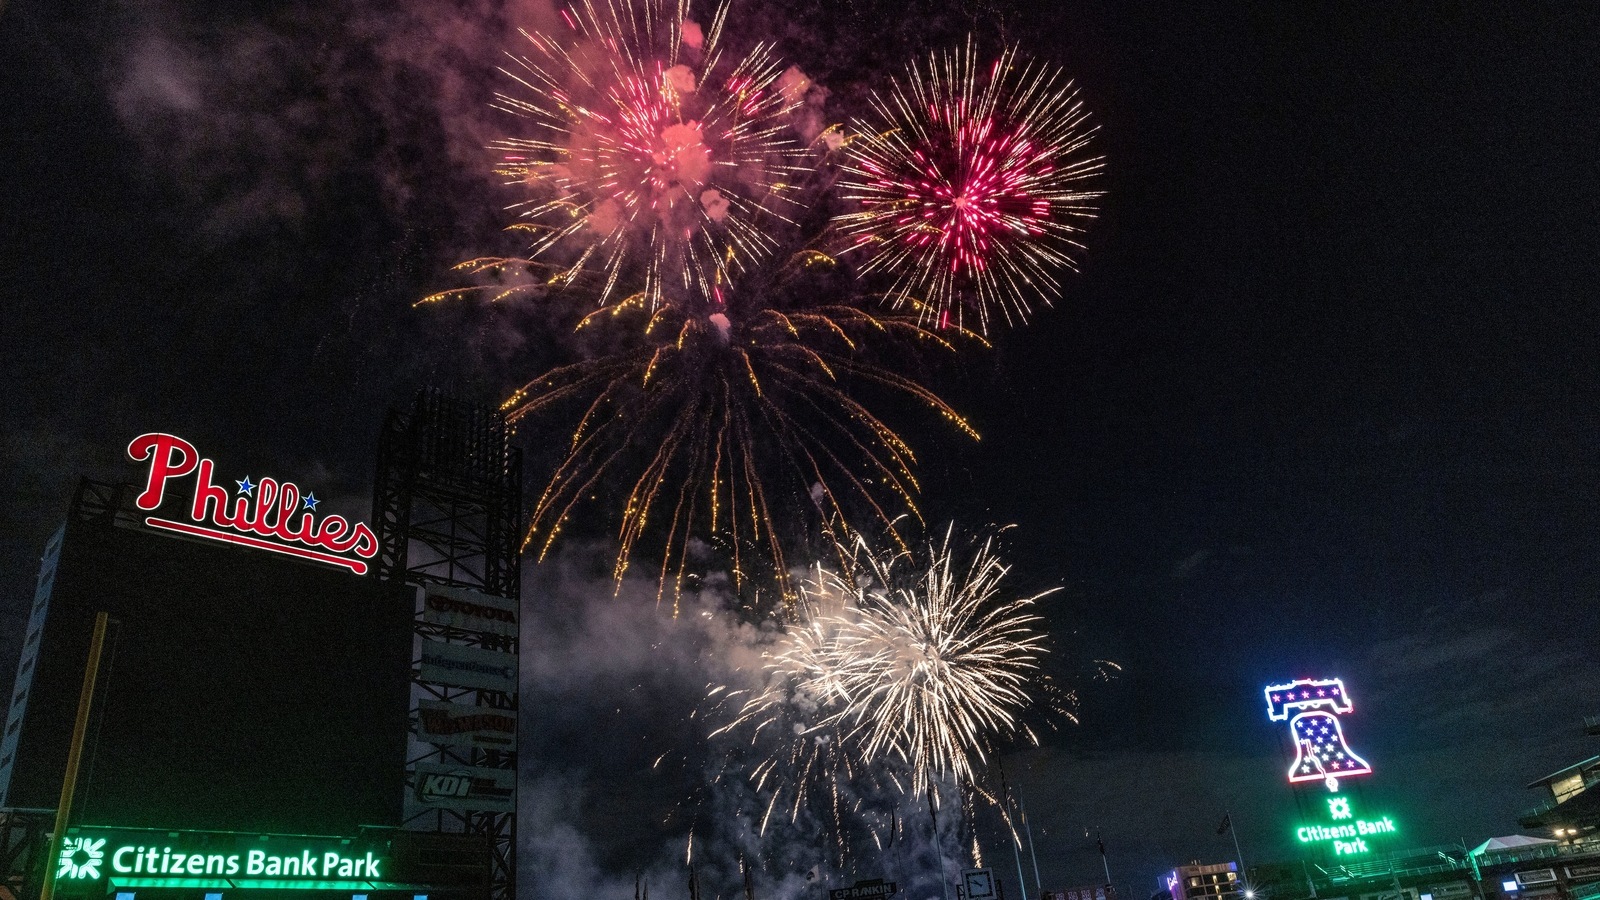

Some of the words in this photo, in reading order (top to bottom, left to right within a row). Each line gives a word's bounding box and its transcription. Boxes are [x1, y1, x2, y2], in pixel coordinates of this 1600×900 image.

[127, 432, 378, 557] Phillies
[450, 600, 515, 622] TOYOTA
[1297, 824, 1357, 843] Citizens
[1356, 816, 1396, 836] Bank
[1333, 837, 1369, 856] Park
[113, 847, 238, 874] Citizens
[246, 851, 317, 875] Bank
[323, 852, 380, 877] Park
